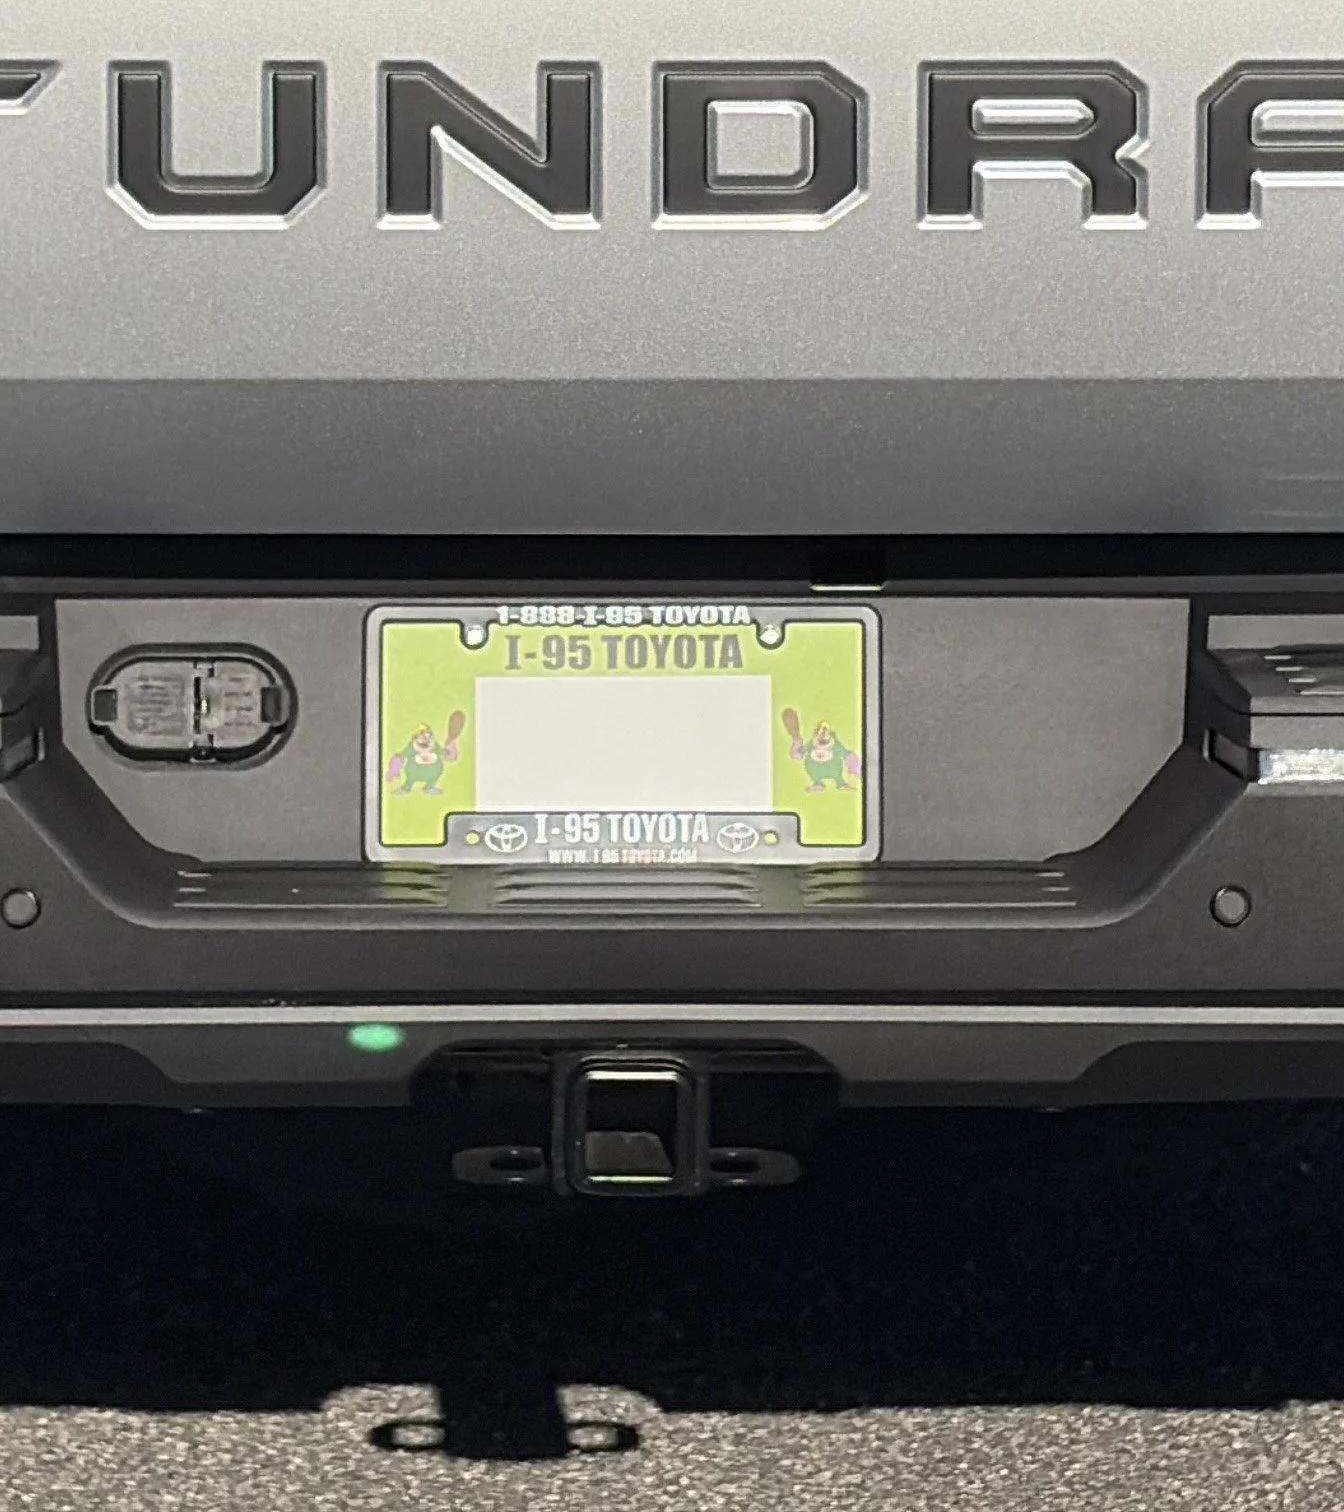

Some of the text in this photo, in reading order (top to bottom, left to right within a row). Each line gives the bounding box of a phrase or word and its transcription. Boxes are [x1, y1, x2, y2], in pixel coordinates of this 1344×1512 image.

[650, 605, 752, 625] TOYOTA
[505, 633, 744, 671] I-95 TOYOTA
[534, 813, 710, 844] I-95 TOYOTA
